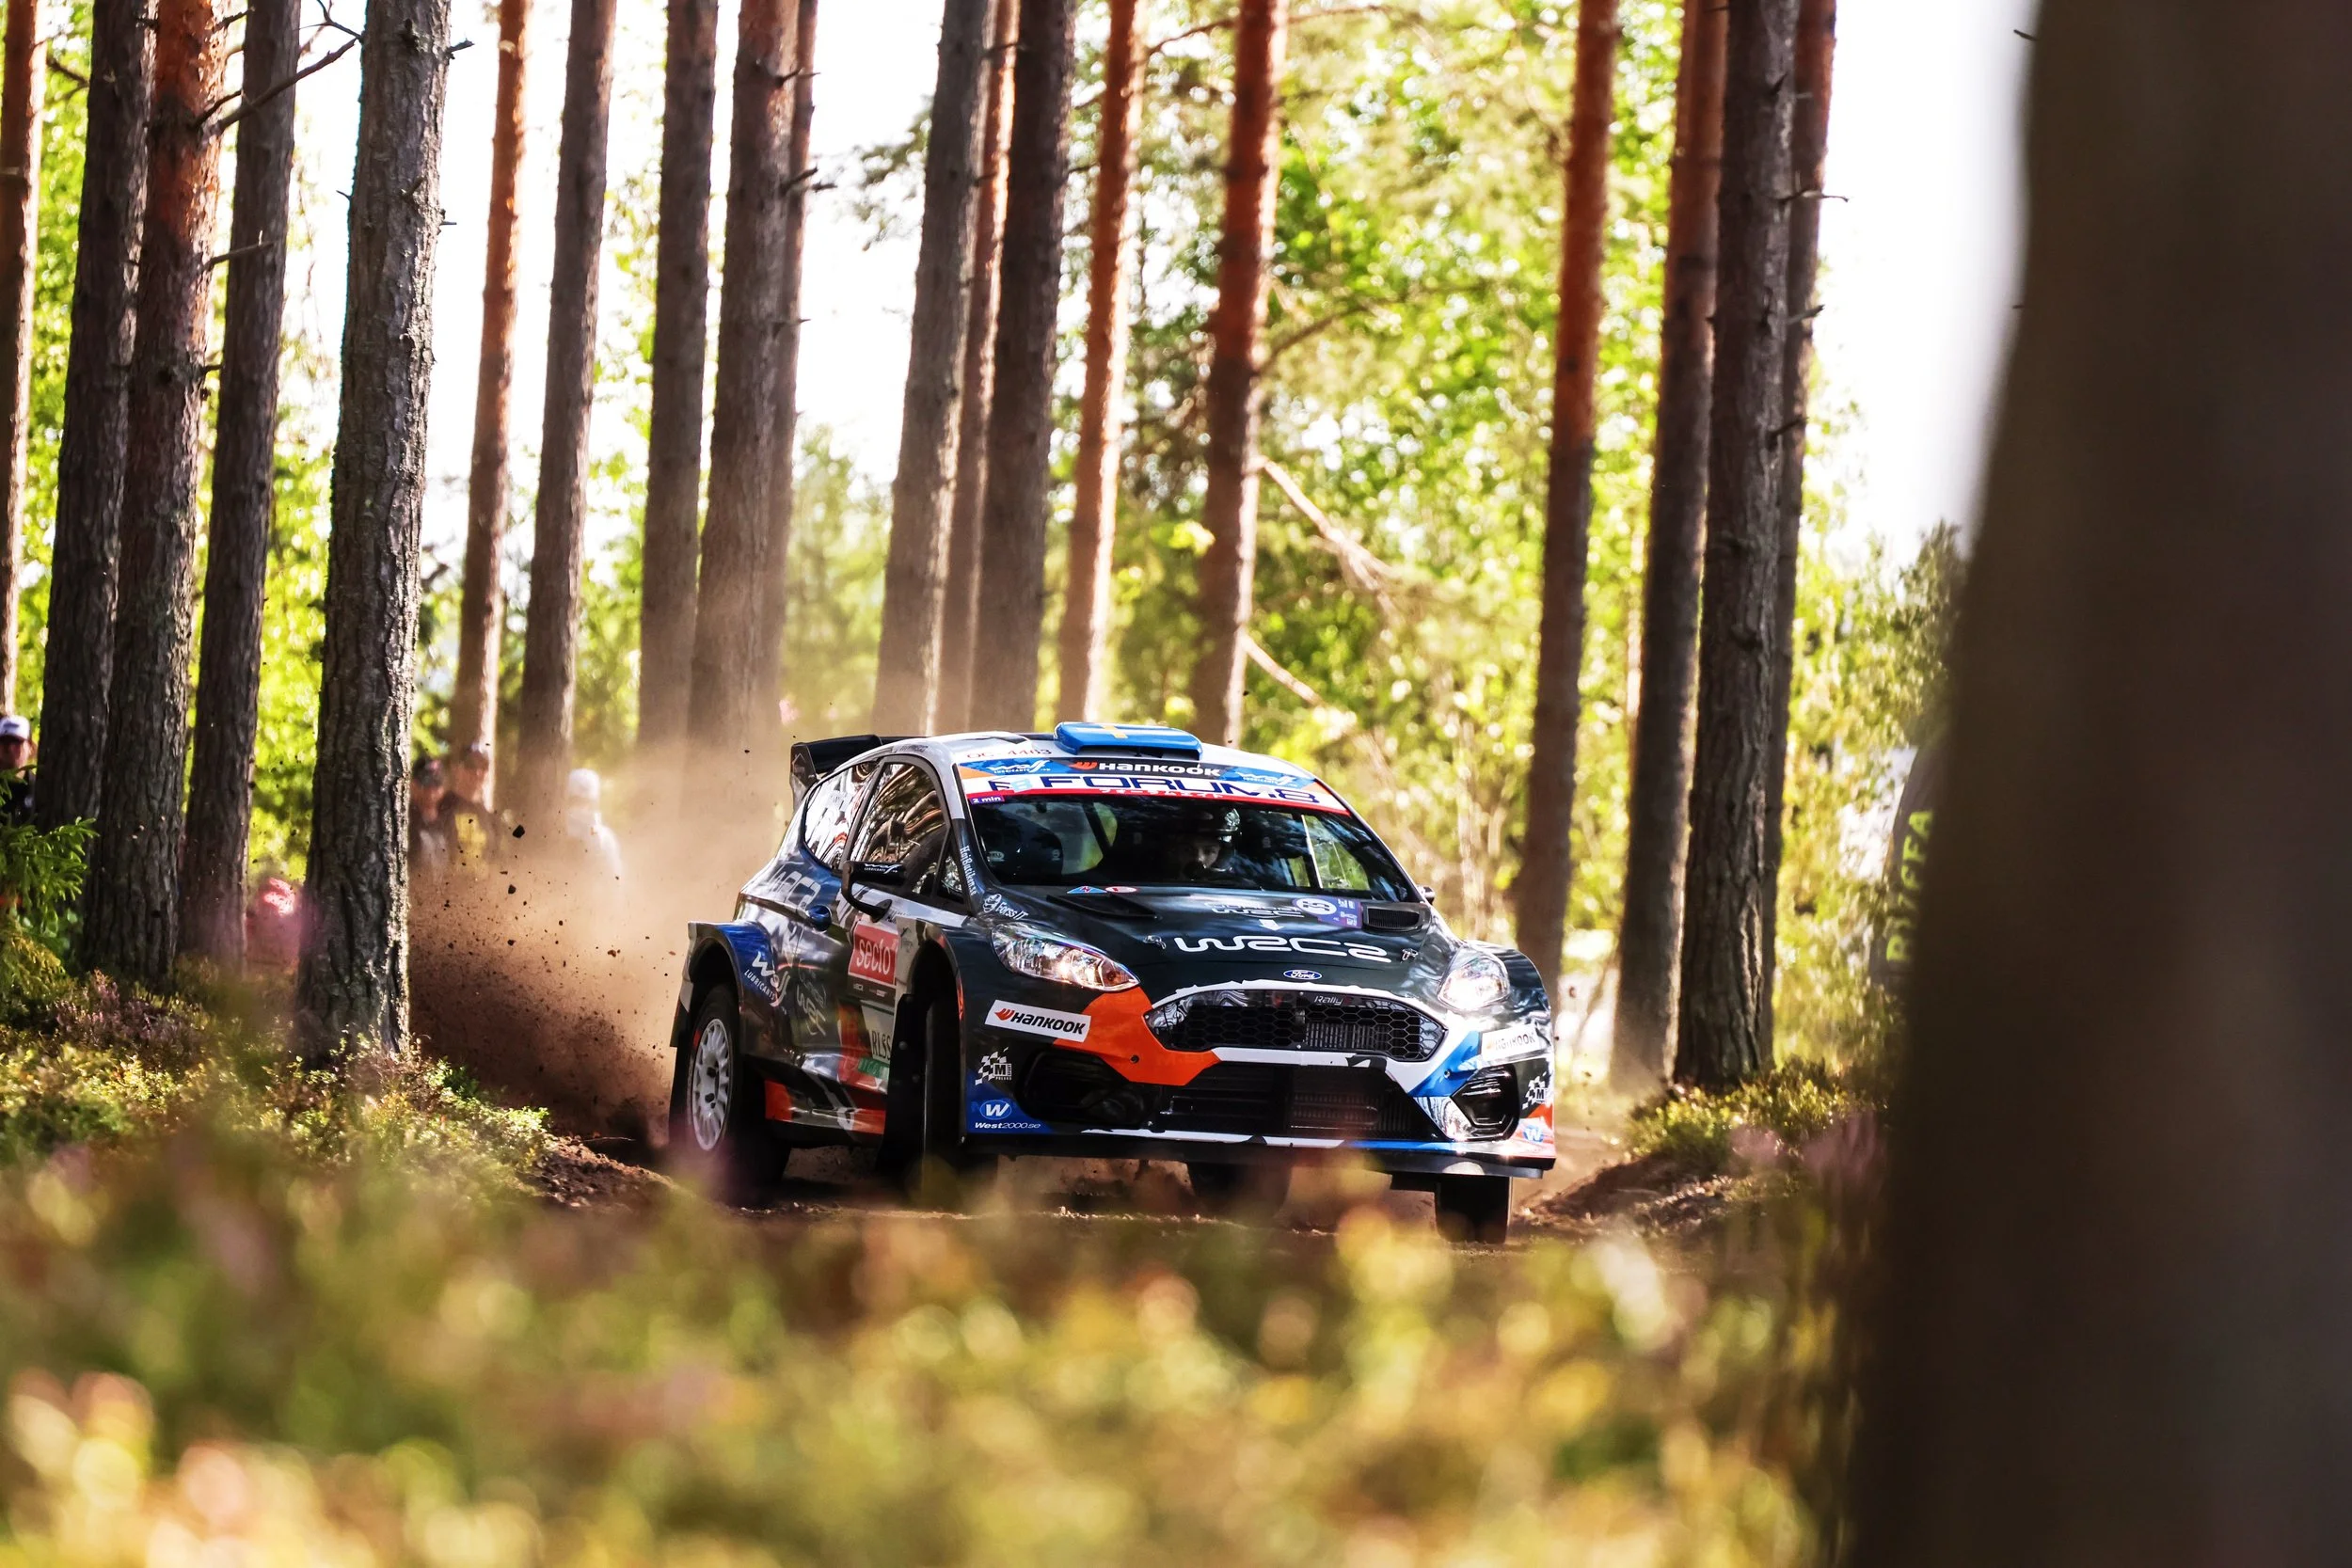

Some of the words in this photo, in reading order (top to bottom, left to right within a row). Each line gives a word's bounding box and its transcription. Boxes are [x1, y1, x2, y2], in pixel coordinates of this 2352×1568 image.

[1040, 775, 1320, 804] FORUM8
[855, 939, 891, 975] secto
[1290, 970, 1315, 978] Ford
[986, 1103, 1009, 1117] W
